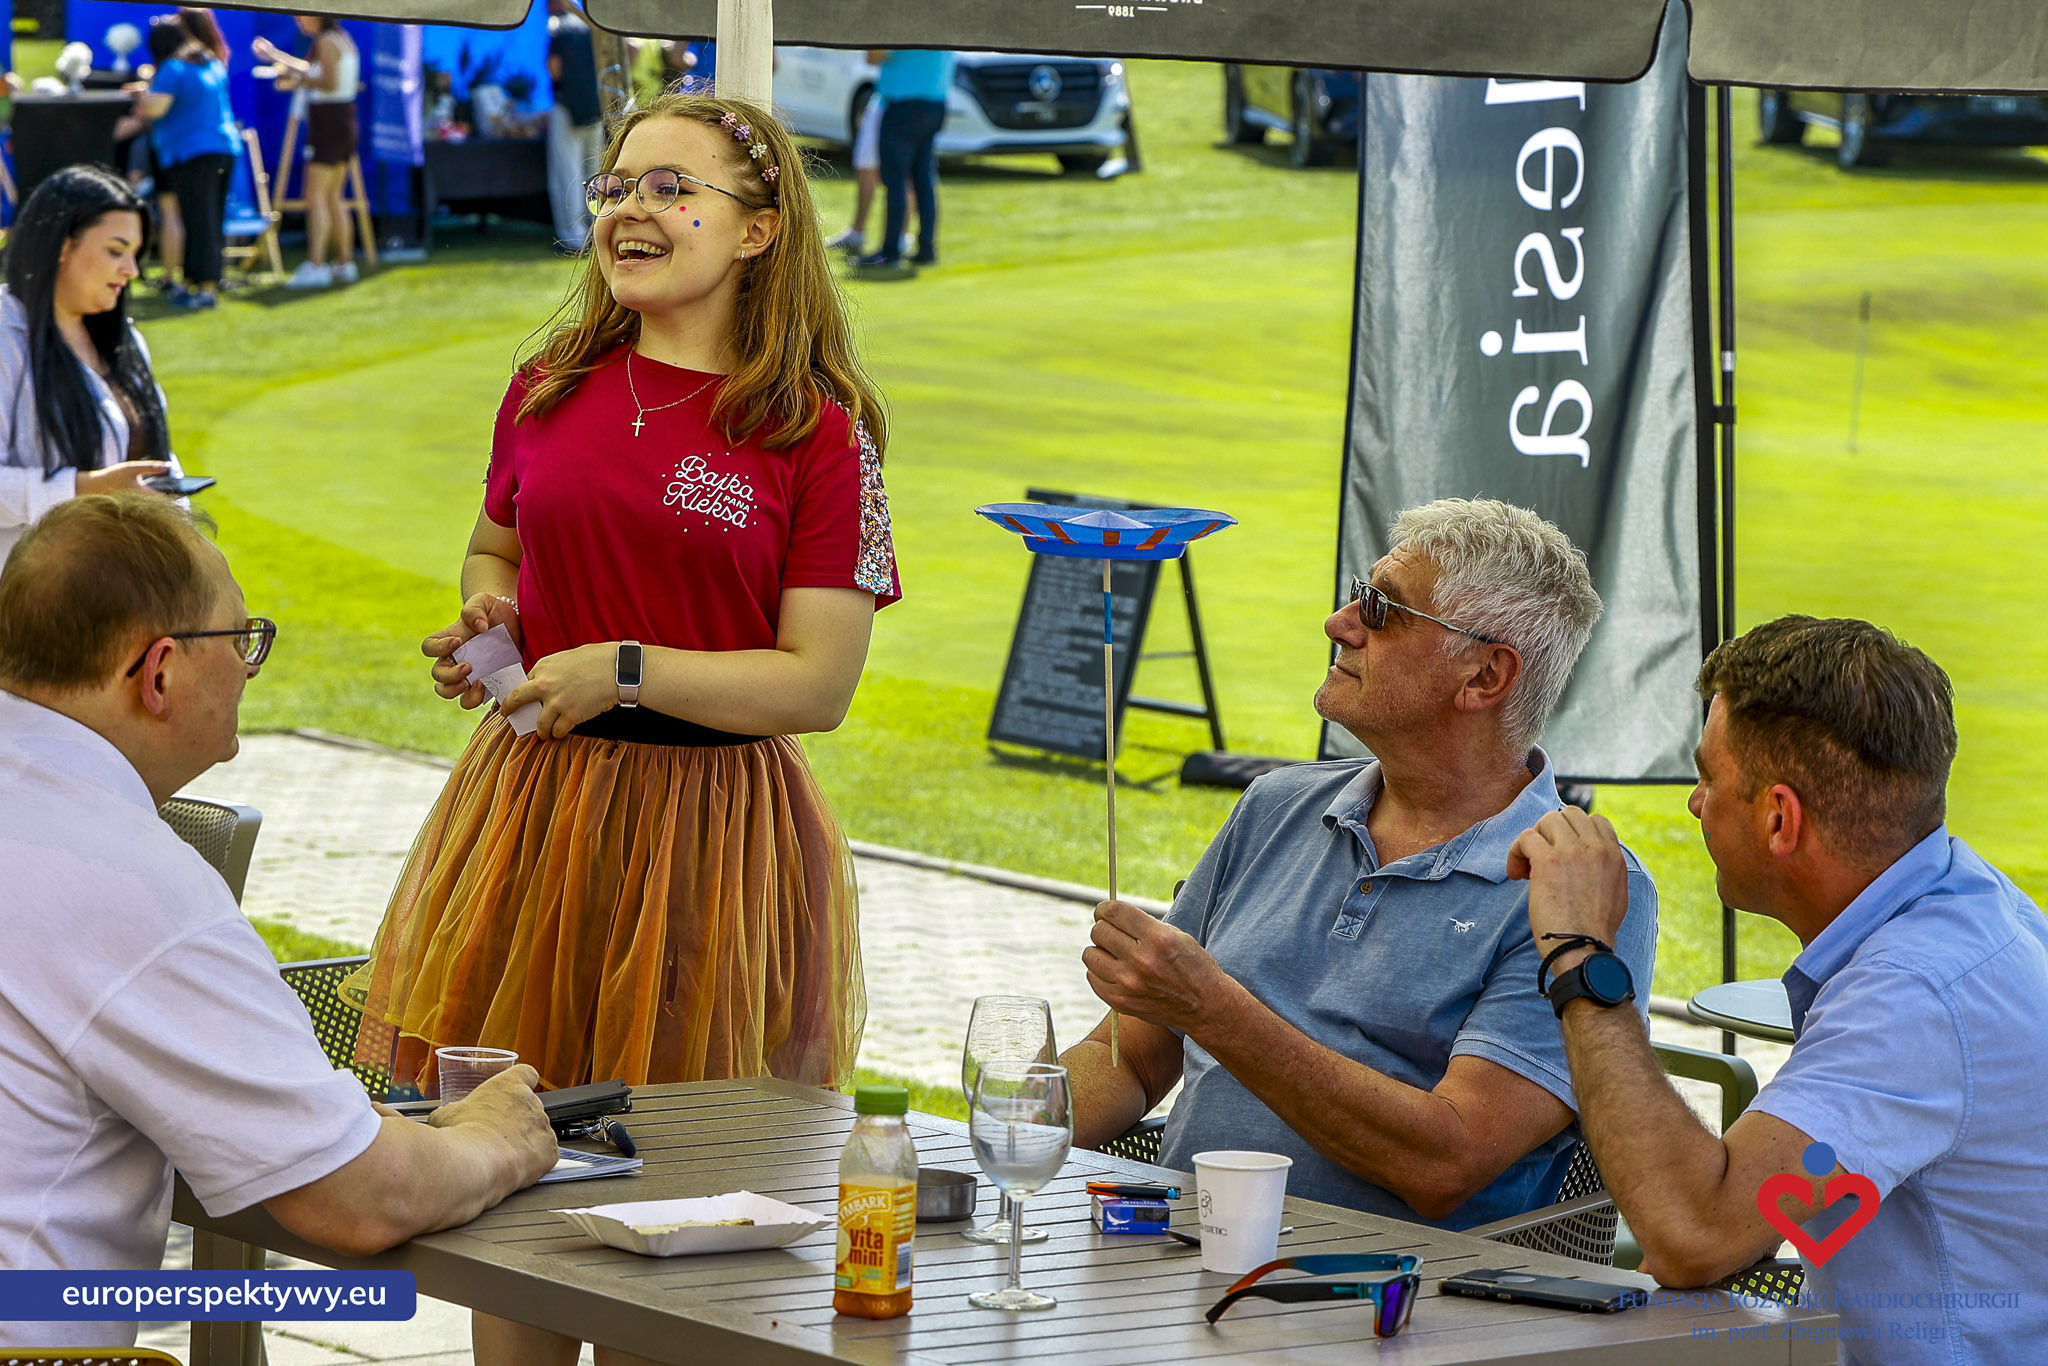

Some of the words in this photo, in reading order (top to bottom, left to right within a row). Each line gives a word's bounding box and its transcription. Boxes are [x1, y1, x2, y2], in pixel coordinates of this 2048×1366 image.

[675, 455, 754, 501] Bajka
[663, 481, 747, 528] Kleksa
[723, 495, 750, 513] PANA
[850, 1228, 884, 1249] vita
[850, 1248, 884, 1266] mini
